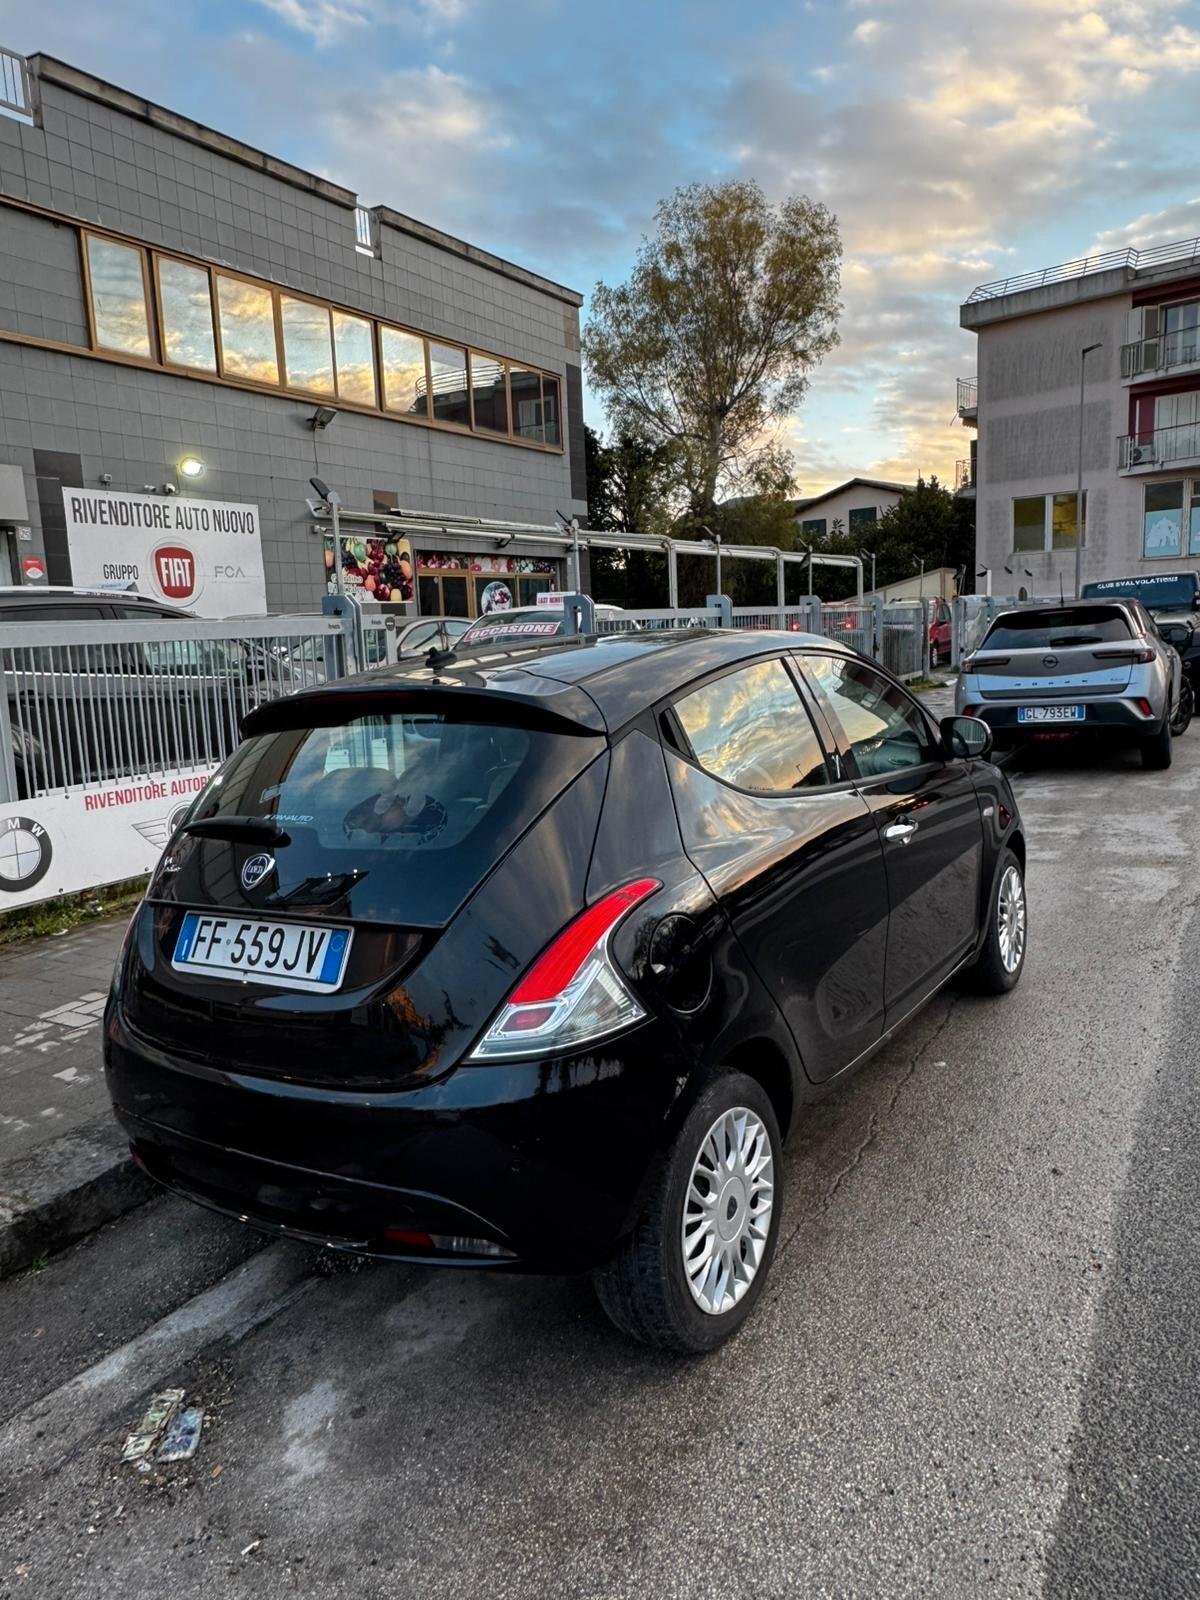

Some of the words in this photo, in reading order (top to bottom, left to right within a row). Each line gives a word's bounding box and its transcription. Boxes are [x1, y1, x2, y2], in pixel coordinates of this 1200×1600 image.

[71, 497, 172, 529] RIVENDITORE
[175, 506, 210, 531] AUTO
[212, 509, 255, 534] NUOVO
[103, 564, 139, 580] GRUPPO
[159, 557, 191, 588] FIAT
[214, 565, 246, 578] FCA
[471, 623, 555, 639] OCCASIONE
[84, 782, 168, 811] RIVENDITORE
[7, 817, 45, 838] MW
[191, 920, 228, 960] FF
[230, 924, 327, 974] 559JV
